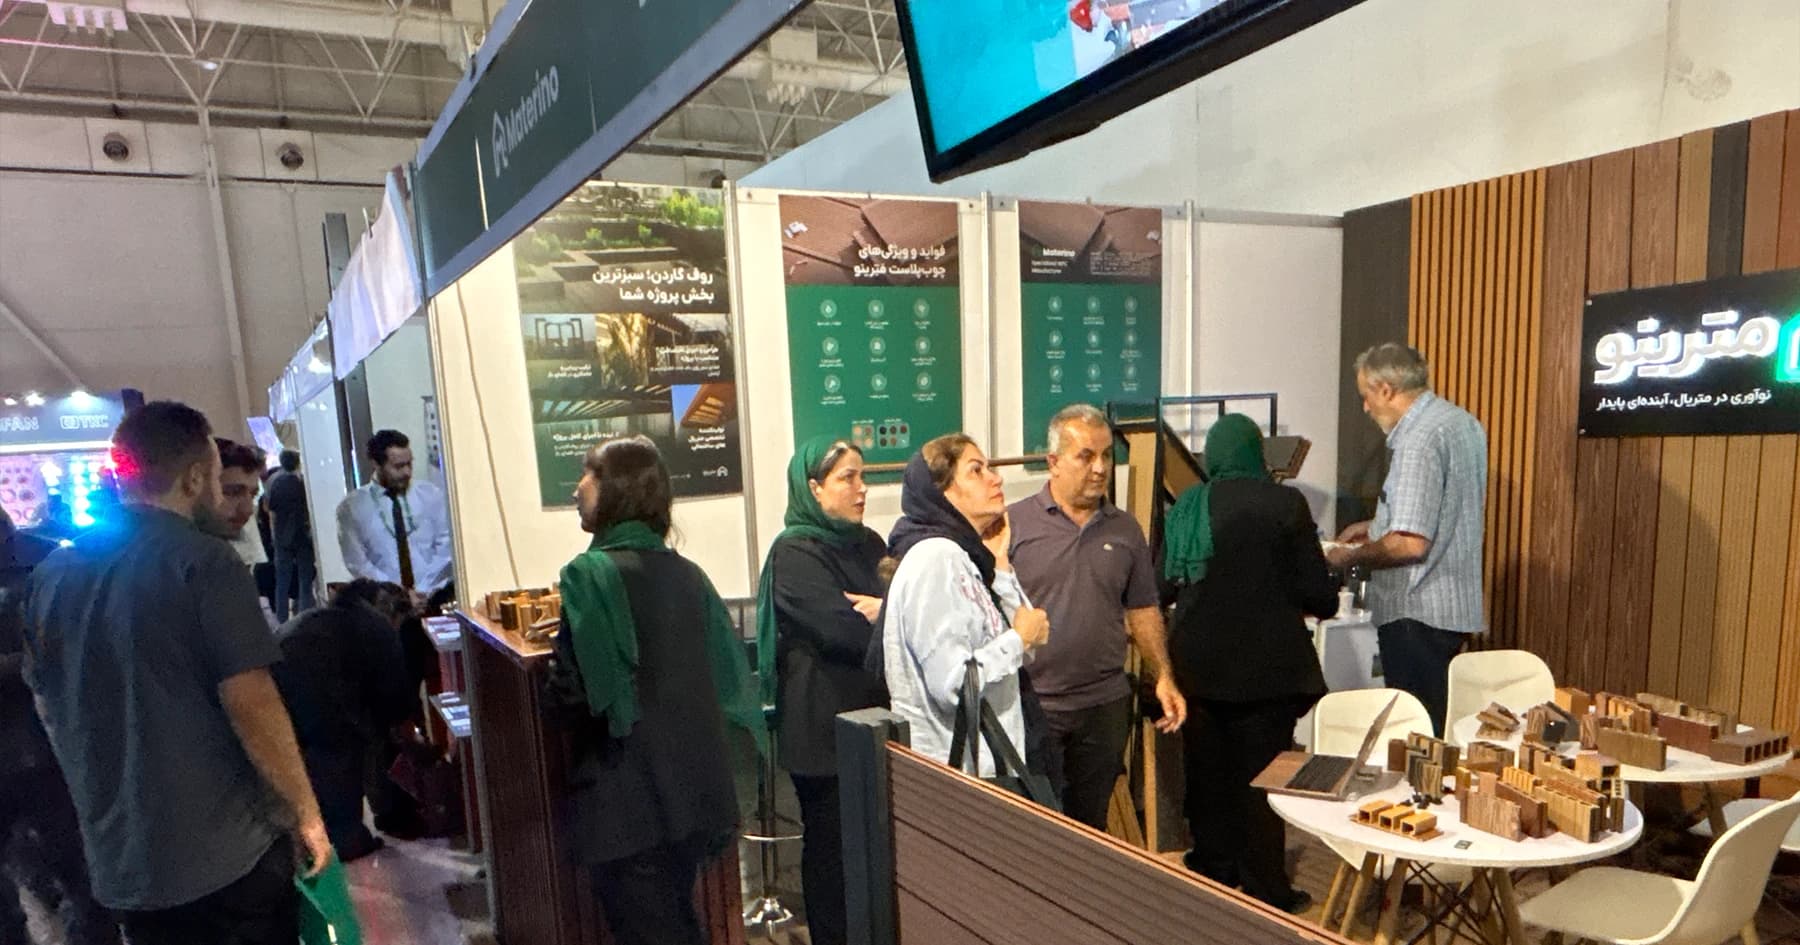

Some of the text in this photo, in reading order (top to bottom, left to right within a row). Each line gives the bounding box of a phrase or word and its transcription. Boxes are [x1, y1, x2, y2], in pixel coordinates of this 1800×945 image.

[505, 65, 559, 154] Materino
[910, 247, 917, 260] و
[919, 244, 946, 260] فواید
[592, 267, 645, 284] سبزترین
[686, 266, 713, 284] روف
[619, 286, 714, 306] بخش پروژه شما
[1593, 308, 1781, 385] مترینو
[1596, 395, 1626, 412] پایدار
[1713, 391, 1728, 406] در
[1730, 387, 1772, 406] نوآوری
